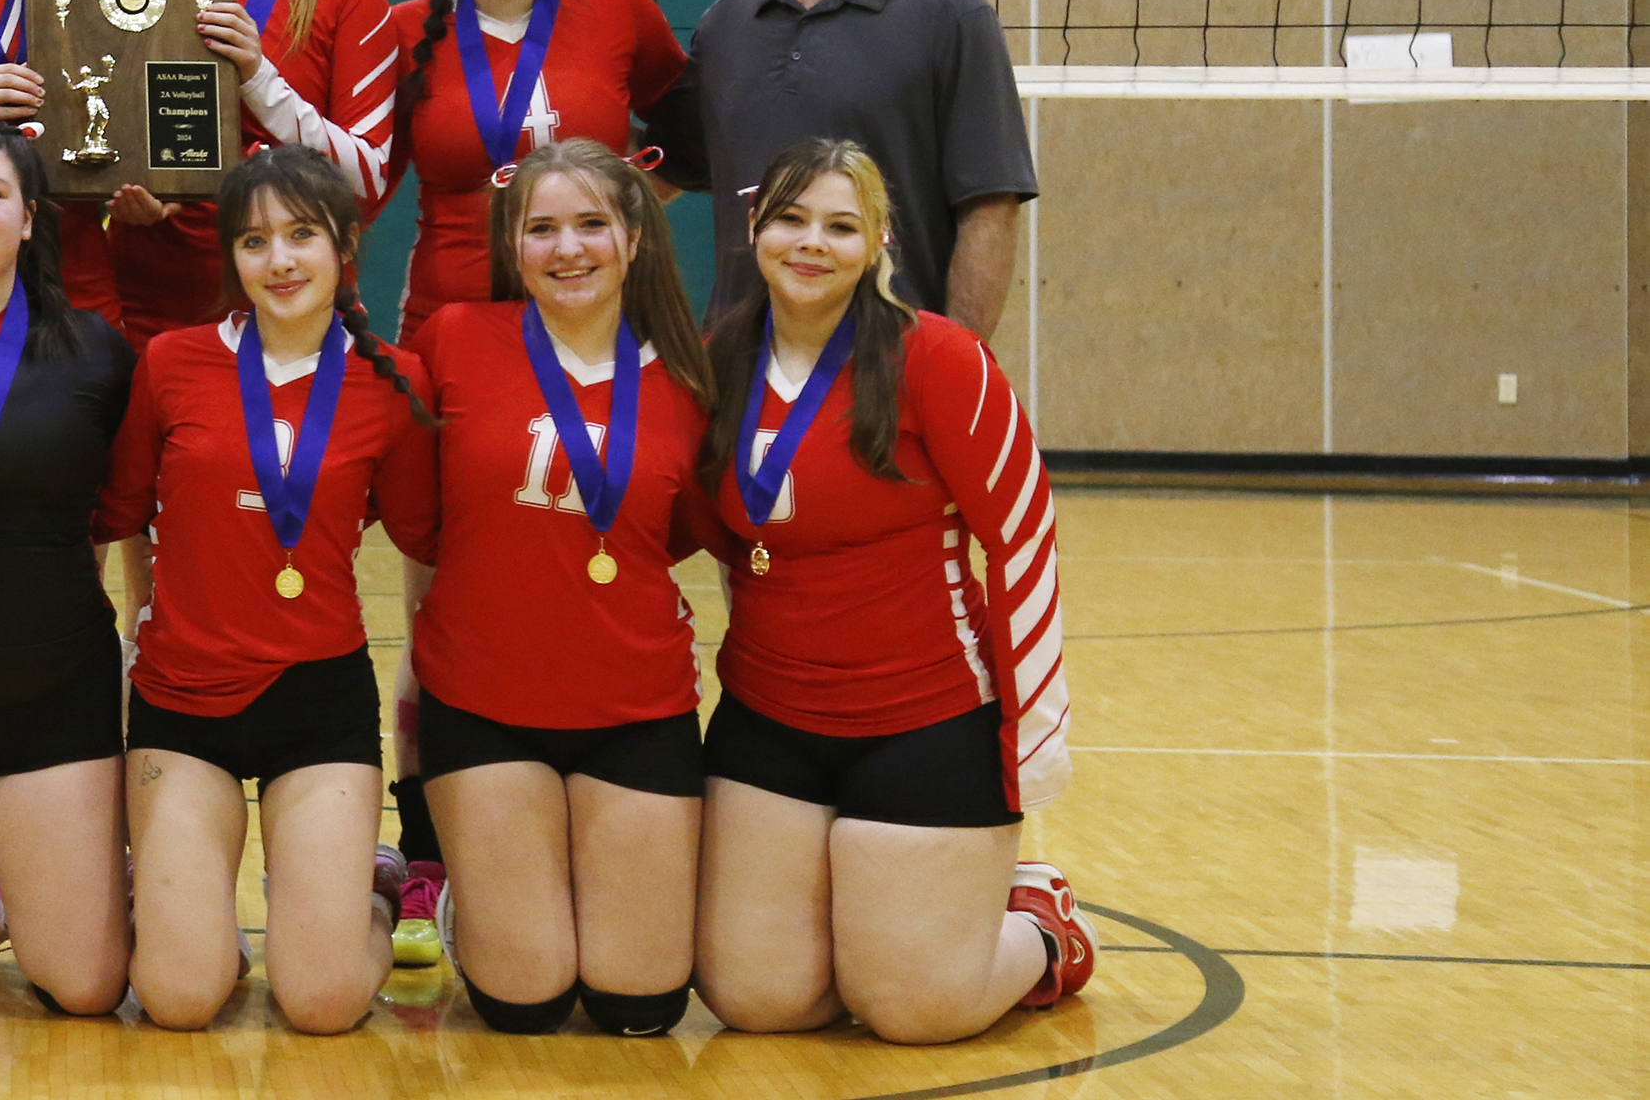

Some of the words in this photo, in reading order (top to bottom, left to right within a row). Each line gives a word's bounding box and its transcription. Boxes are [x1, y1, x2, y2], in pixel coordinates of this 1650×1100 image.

[178, 73, 201, 82] Region
[160, 91, 171, 99] 2A
[172, 91, 206, 100] Volleyball
[158, 107, 209, 118] Champions
